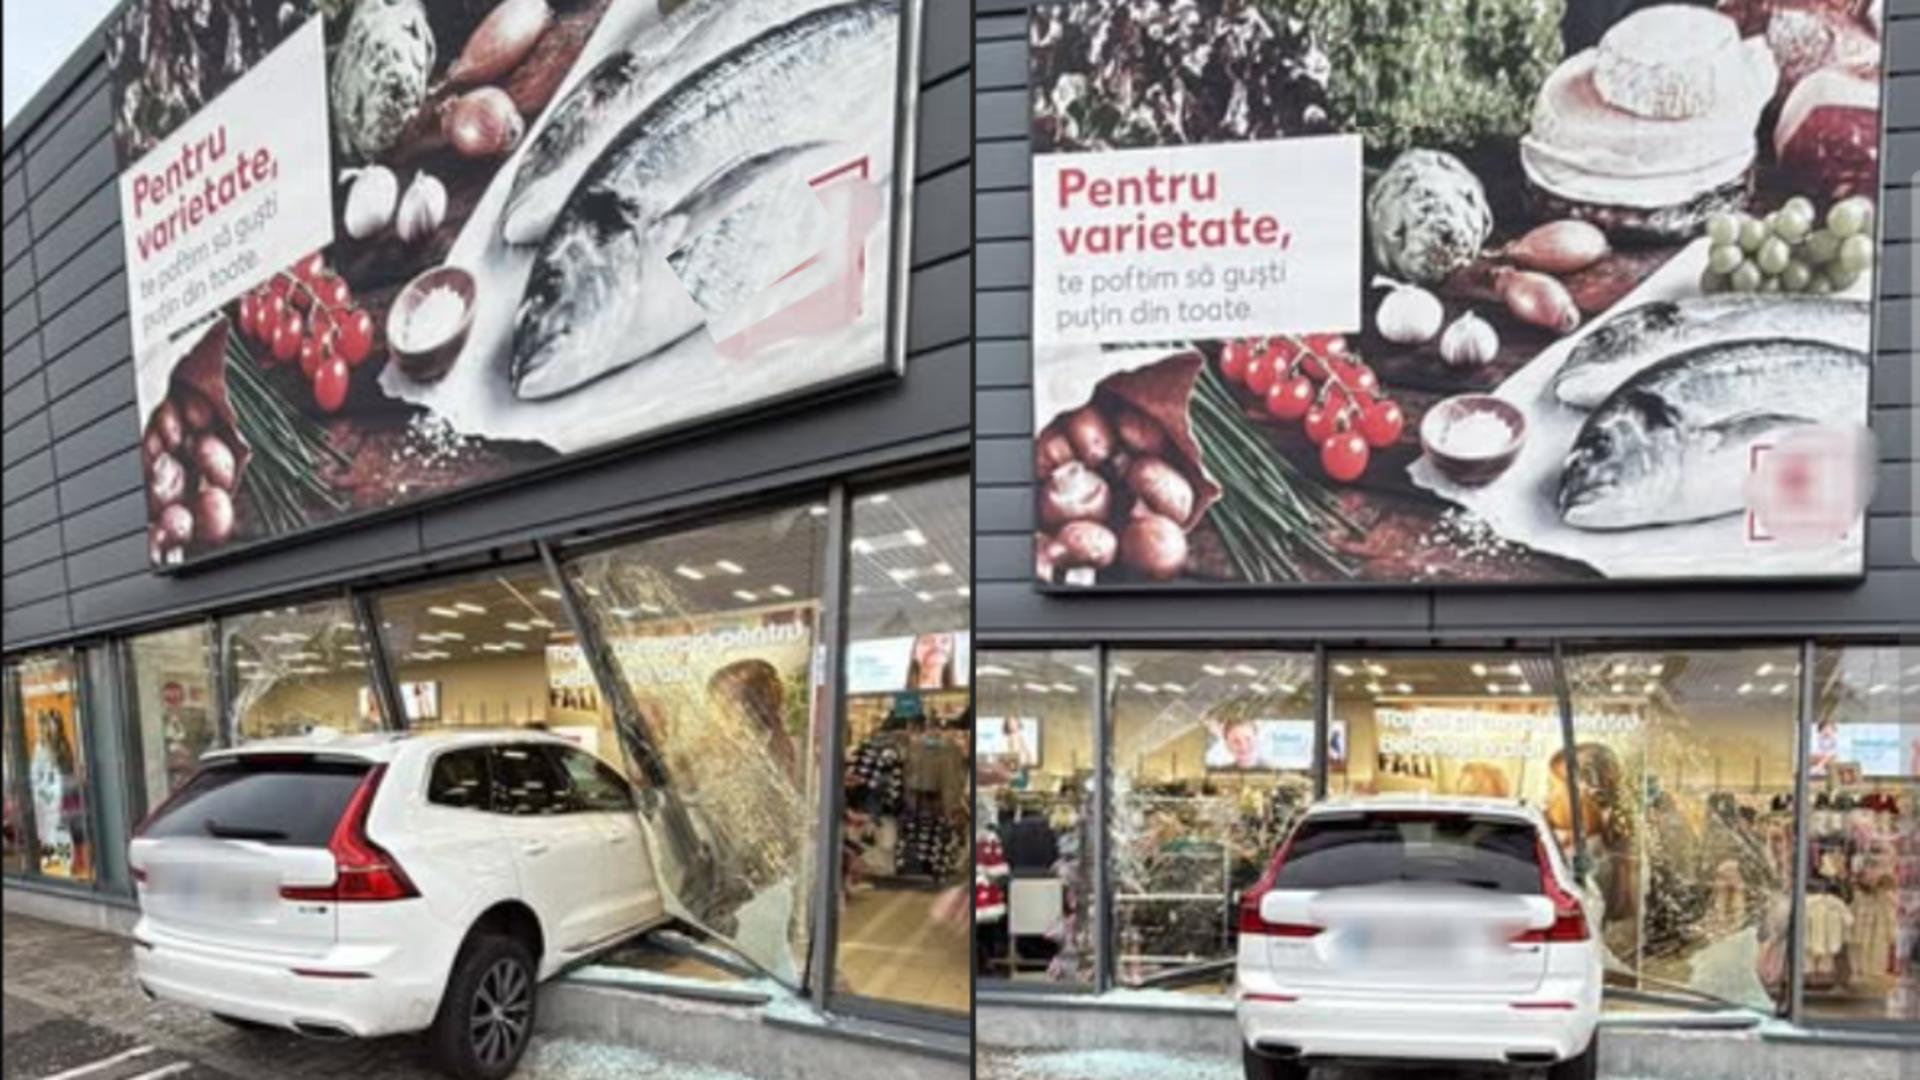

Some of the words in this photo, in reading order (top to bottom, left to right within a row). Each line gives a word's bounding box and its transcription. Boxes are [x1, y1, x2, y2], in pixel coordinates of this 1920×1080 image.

[133, 125, 227, 217] Pentru
[1058, 166, 1216, 208] Pentru
[137, 147, 278, 260] varietate,
[1057, 208, 1292, 253] varietate,
[140, 277, 157, 299] te
[158, 242, 210, 292] poftim
[211, 222, 234, 255] să
[1058, 271, 1084, 294] te
[1090, 264, 1179, 297] poftim
[1185, 262, 1216, 287] să
[1223, 259, 1288, 293] guști
[182, 278, 208, 308] din
[1056, 303, 1123, 332] puțin
[1130, 300, 1171, 326] din
